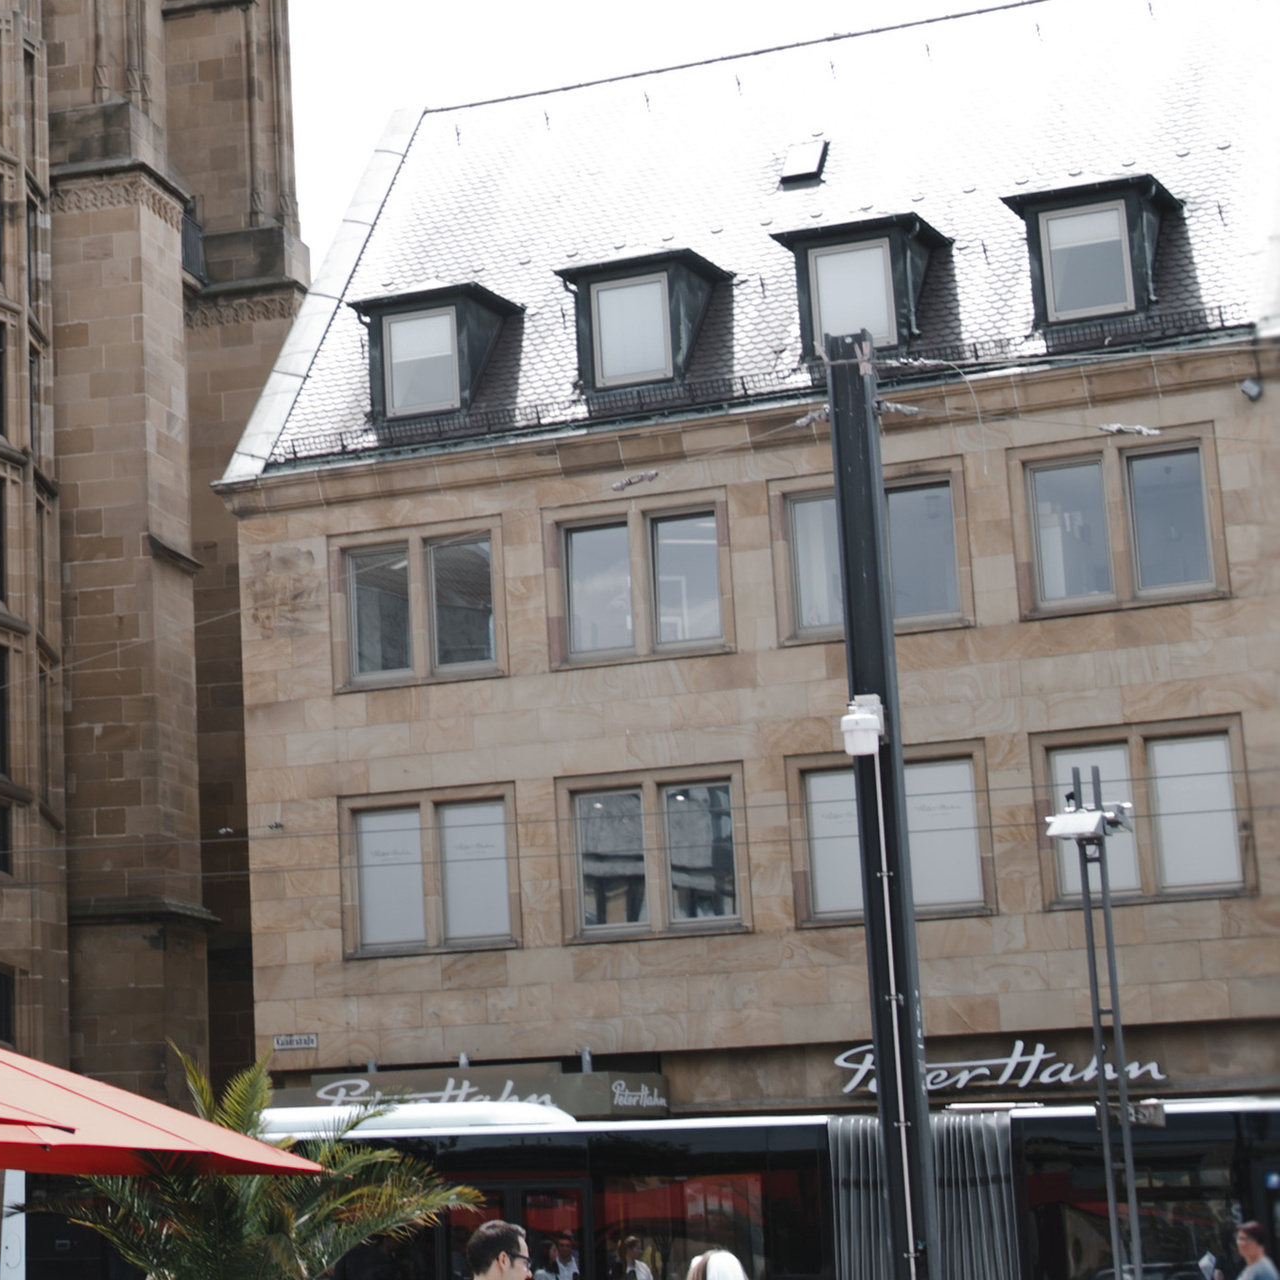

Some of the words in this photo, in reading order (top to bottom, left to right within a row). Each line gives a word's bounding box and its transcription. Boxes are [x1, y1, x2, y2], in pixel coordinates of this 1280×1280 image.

[834, 1044, 991, 1093] Per
[611, 1080, 640, 1106] Peter
[640, 1083, 668, 1108] Hahn
